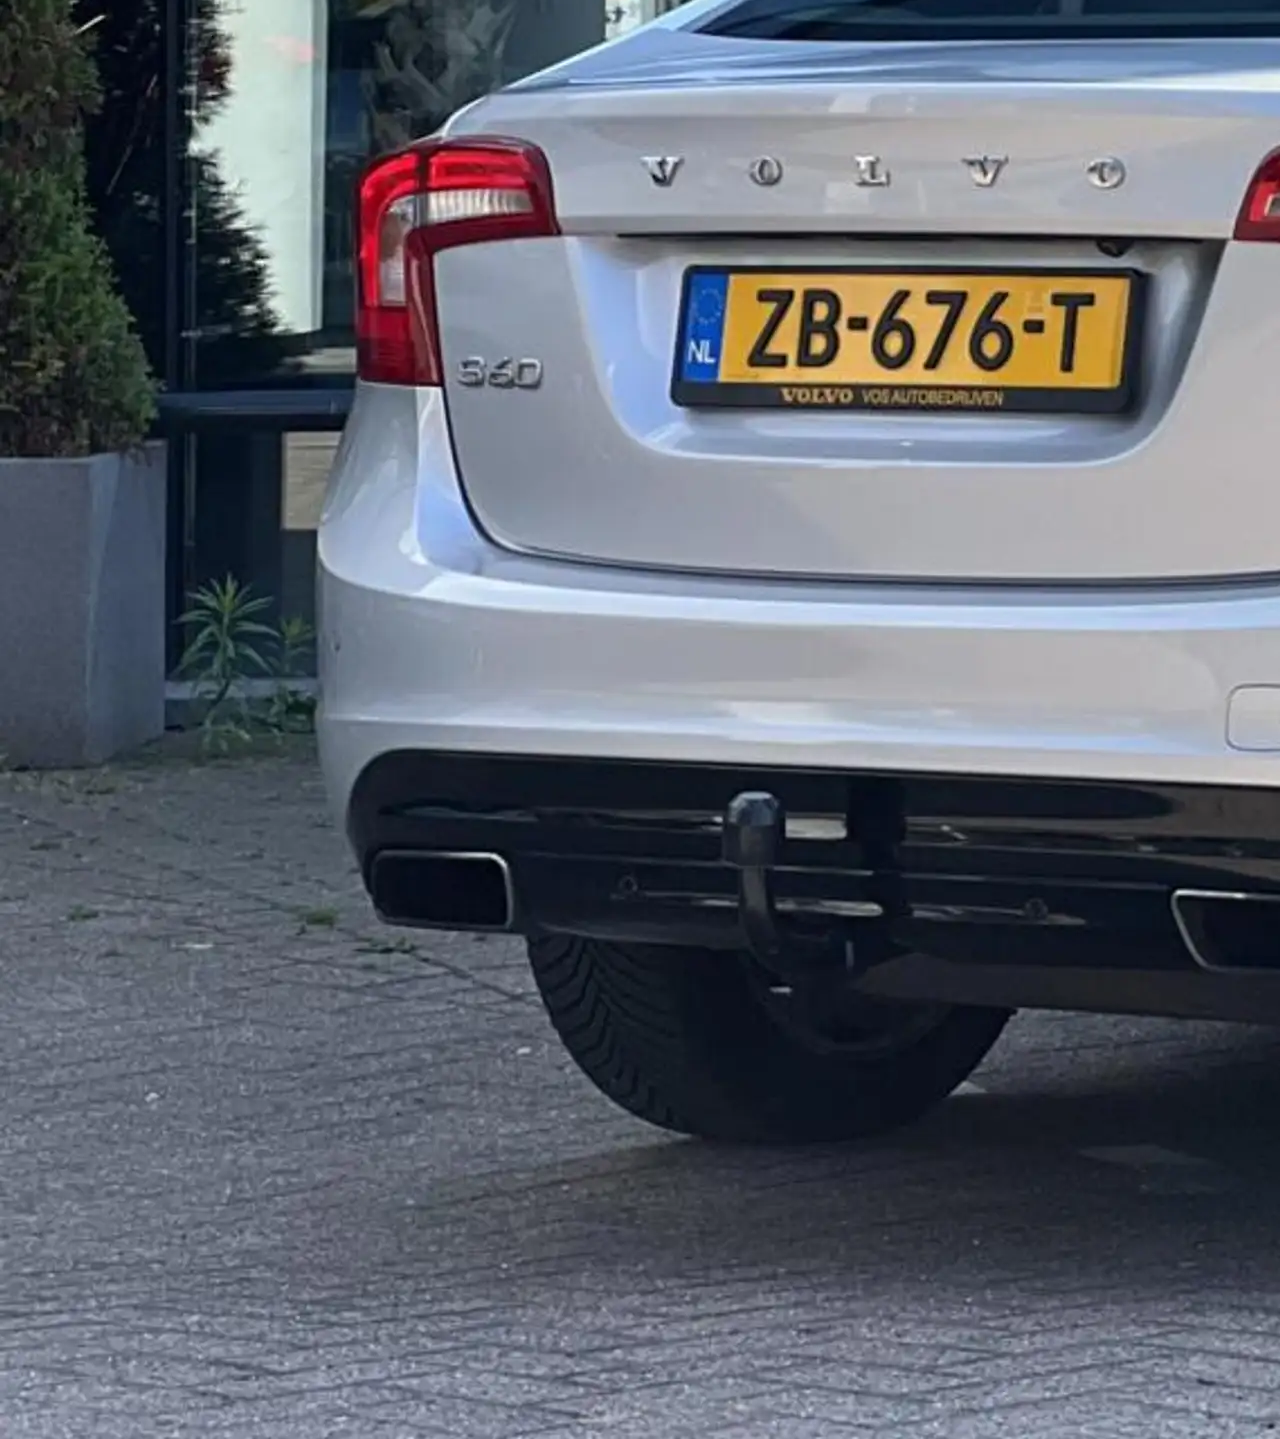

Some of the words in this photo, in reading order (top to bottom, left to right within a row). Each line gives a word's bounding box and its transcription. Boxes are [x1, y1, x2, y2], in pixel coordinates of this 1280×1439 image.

[641, 153, 1127, 190] VOLVO
[688, 340, 716, 363] NL
[746, 288, 1096, 373] ZB-676-T
[456, 353, 545, 391] S60
[780, 386, 855, 406] VOLVO
[861, 388, 889, 405] VOS
